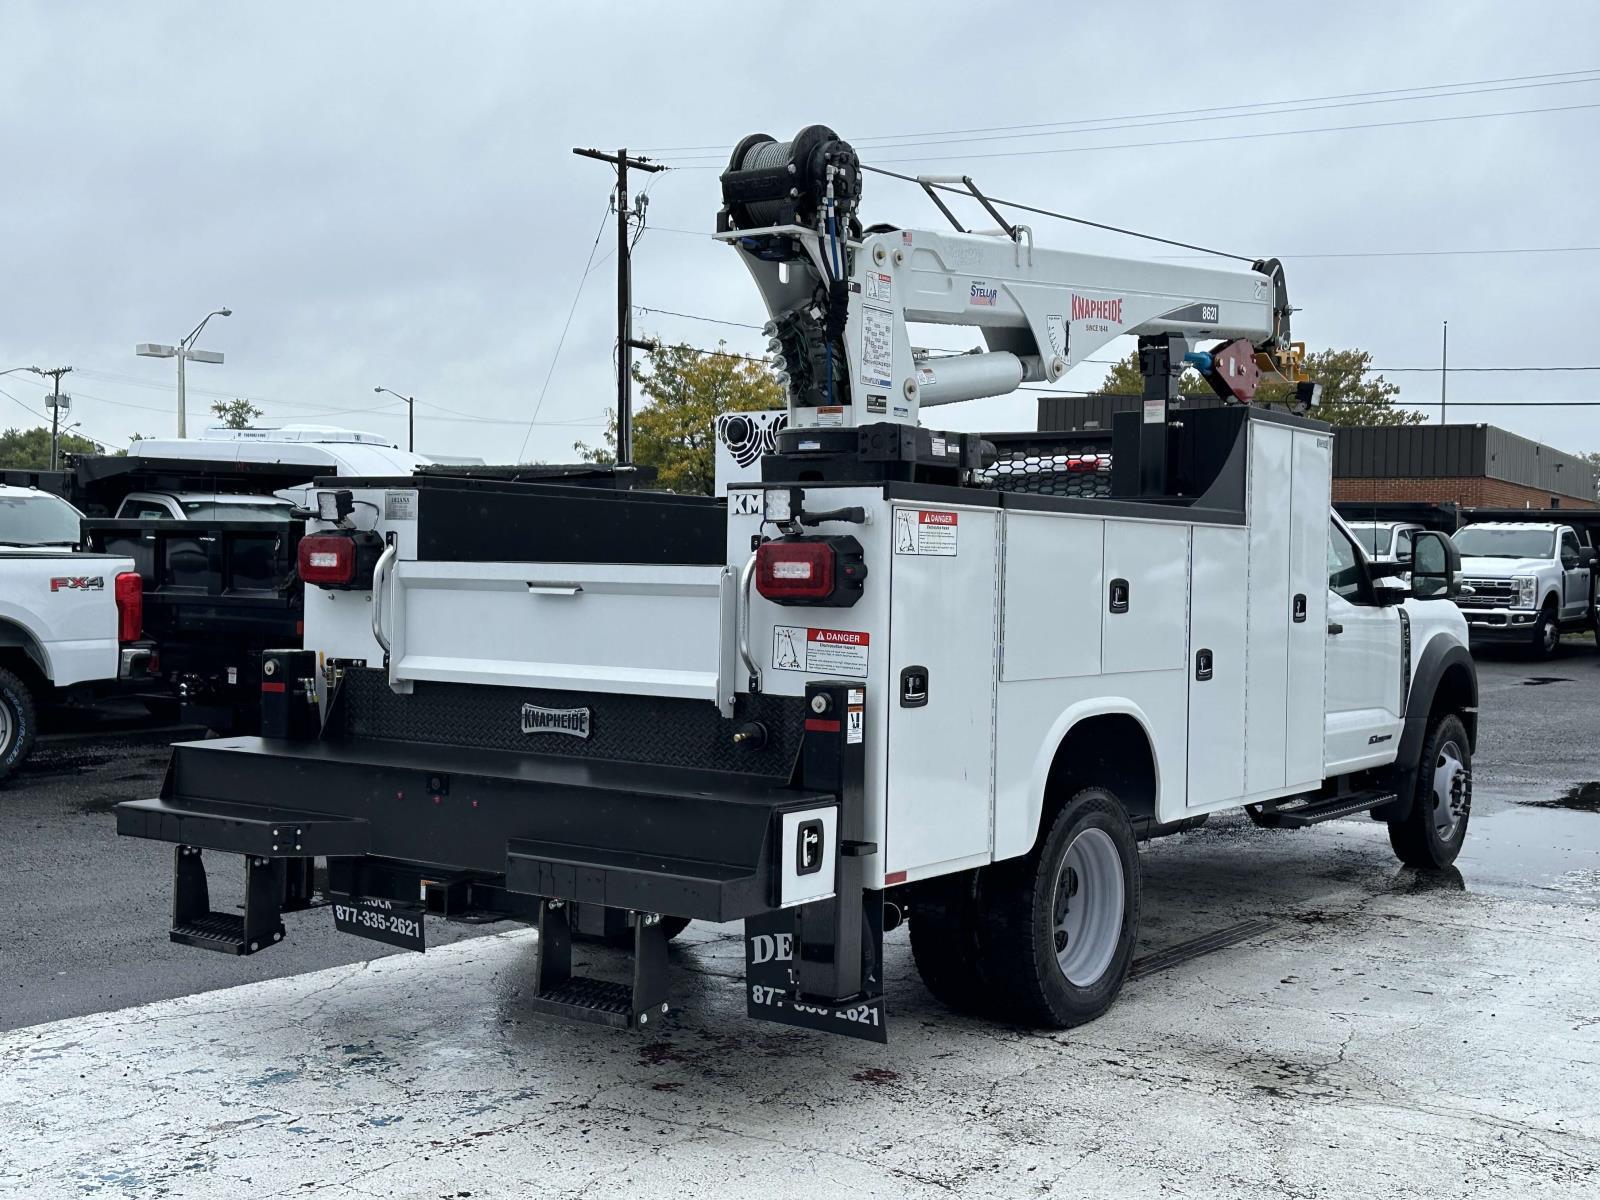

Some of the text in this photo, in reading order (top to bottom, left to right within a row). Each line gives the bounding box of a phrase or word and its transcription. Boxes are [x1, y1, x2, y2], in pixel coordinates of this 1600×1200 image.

[971, 284, 997, 299] STELLAR
[1071, 293, 1122, 325] KNAPHEIDE
[1202, 306, 1217, 320] 8621
[1085, 324, 1098, 332] SINCE
[930, 514, 953, 523] DANGER
[51, 576, 104, 592] FX4
[826, 633, 860, 643] DANGER
[524, 708, 587, 733] KNAPHEIDE
[336, 905, 420, 938] 877-335-2621
[751, 933, 793, 964] DE
